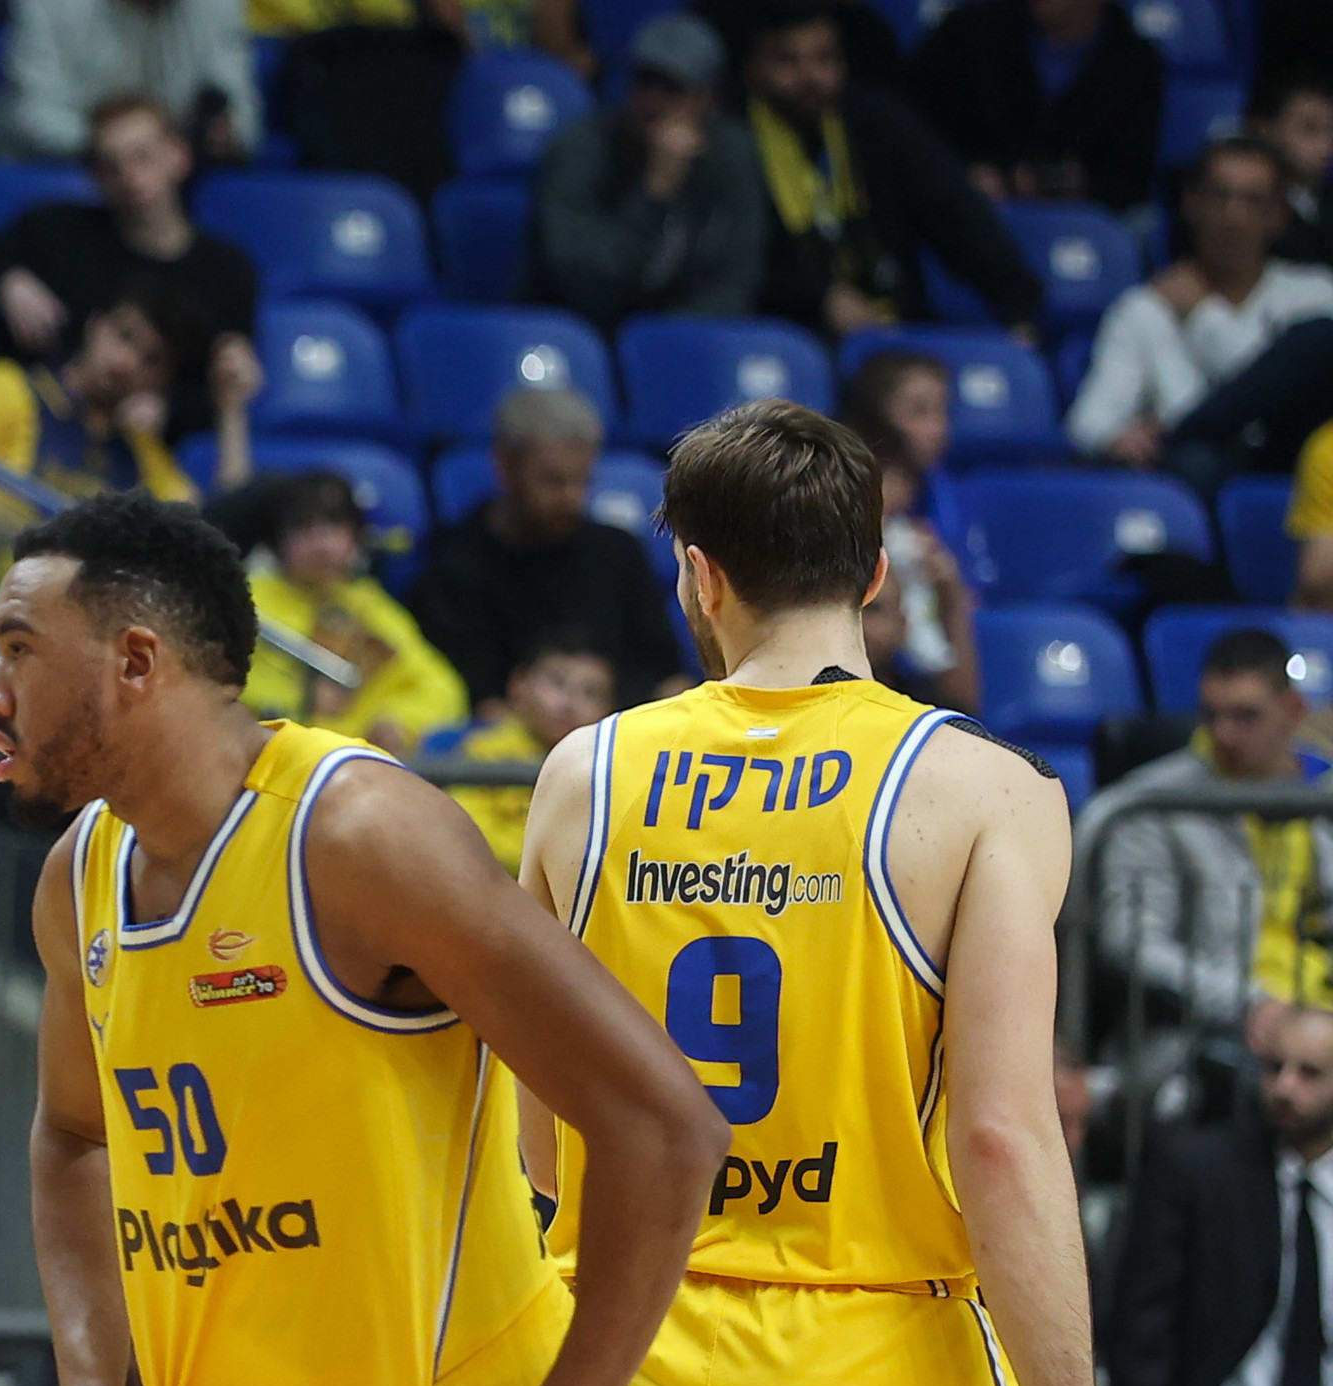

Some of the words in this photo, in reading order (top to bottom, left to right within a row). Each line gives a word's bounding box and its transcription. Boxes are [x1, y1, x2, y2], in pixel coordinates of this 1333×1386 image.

[644, 750, 853, 830] סורקין
[625, 849, 843, 917] Investing.com
[665, 936, 782, 1125] 9
[114, 1062, 228, 1177] 50
[708, 1141, 838, 1216] pyd
